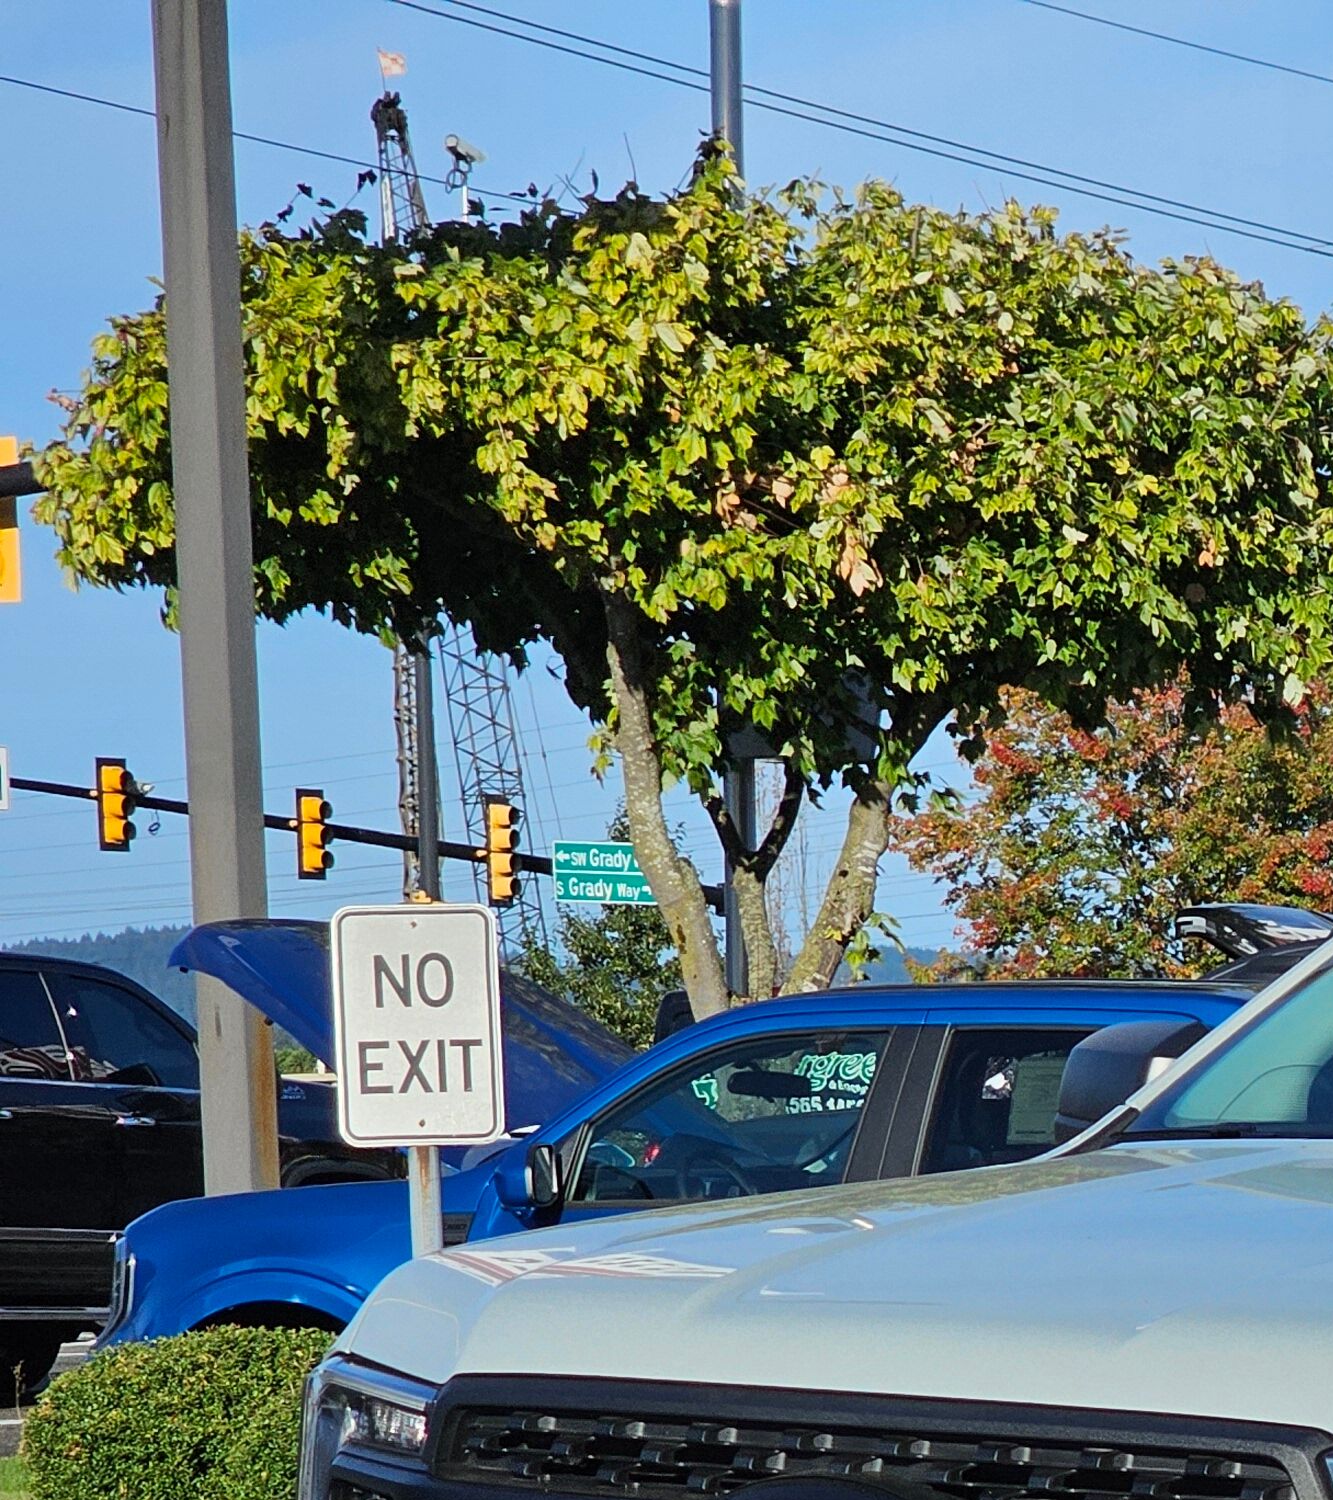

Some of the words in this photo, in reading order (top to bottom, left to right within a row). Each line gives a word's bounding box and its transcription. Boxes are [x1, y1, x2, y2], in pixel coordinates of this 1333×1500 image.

[589, 848, 632, 873] Grady
[556, 880, 565, 896] S
[568, 876, 613, 901] Grady
[616, 883, 641, 901] Way
[373, 952, 454, 1009] NO
[357, 1038, 483, 1095] EXIT
